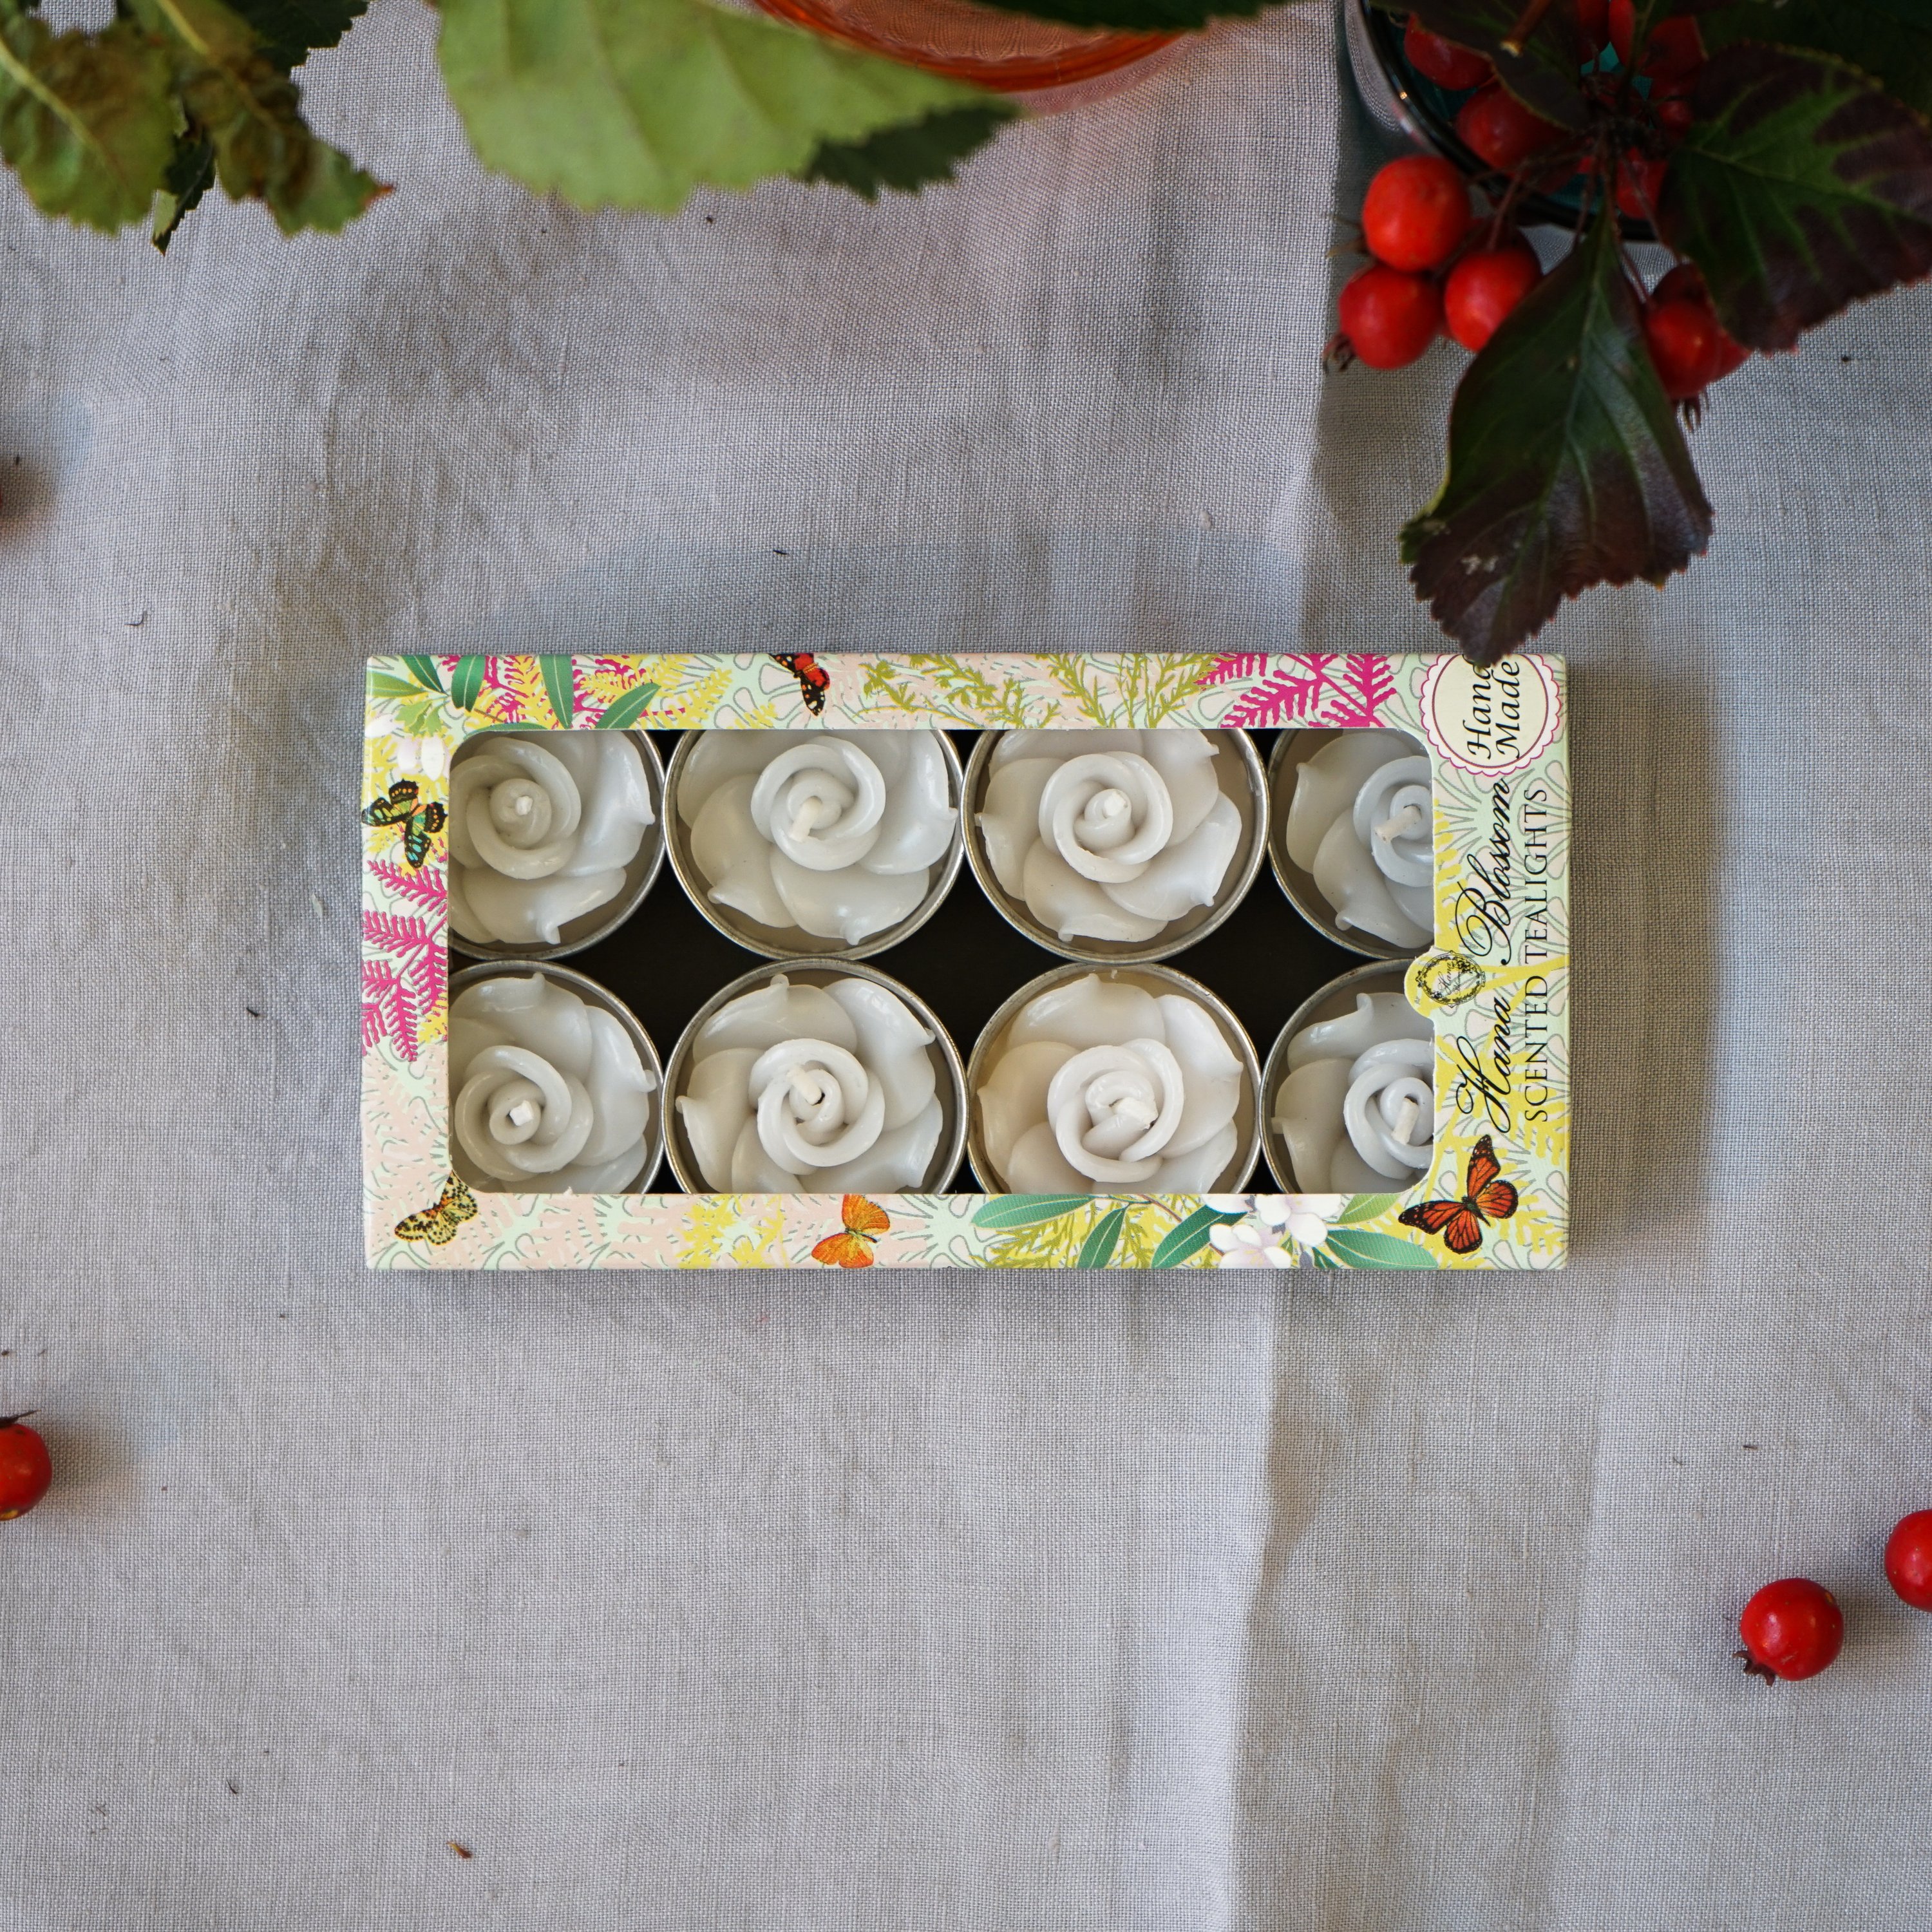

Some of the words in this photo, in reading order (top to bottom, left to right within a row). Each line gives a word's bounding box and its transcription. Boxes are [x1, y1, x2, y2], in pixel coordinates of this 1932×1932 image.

[1491, 661, 1520, 759] Made
[1455, 777, 1511, 966] Blossom
[1524, 789, 1548, 965] TEALIGHTS
[1455, 996, 1511, 1134] Hana
[1524, 975, 1548, 1122] SCENTED
